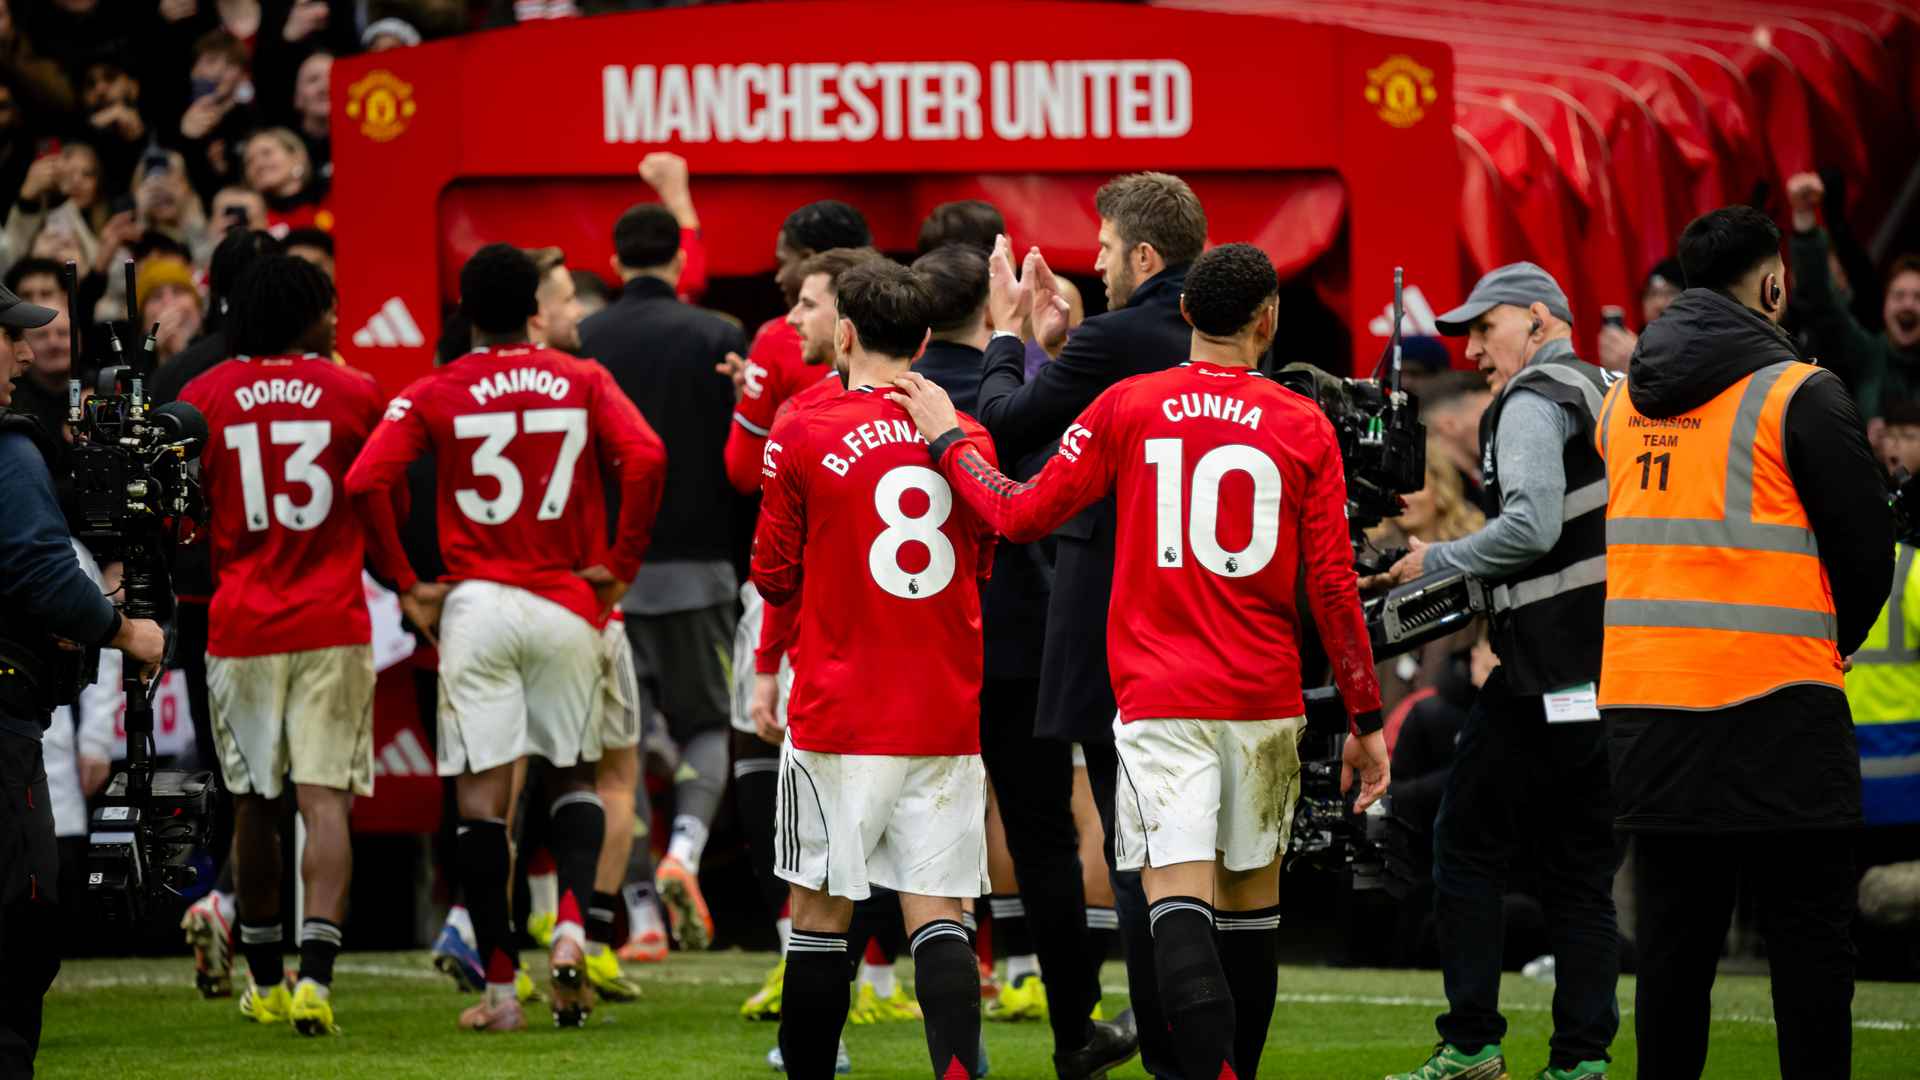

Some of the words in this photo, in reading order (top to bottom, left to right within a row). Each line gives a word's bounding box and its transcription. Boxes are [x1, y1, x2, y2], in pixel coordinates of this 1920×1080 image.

[602, 62, 983, 143] MANCHESTER
[990, 59, 1192, 140] UNITED
[234, 378, 323, 412] DORGU
[469, 367, 570, 406] MAINOO
[1162, 392, 1263, 431] CUNHA
[453, 408, 588, 526] 37
[1636, 451, 1671, 491] 11
[1643, 434, 1679, 448] TEAM
[223, 420, 334, 532] 13
[868, 465, 956, 600] 8
[1144, 437, 1283, 578] 10
